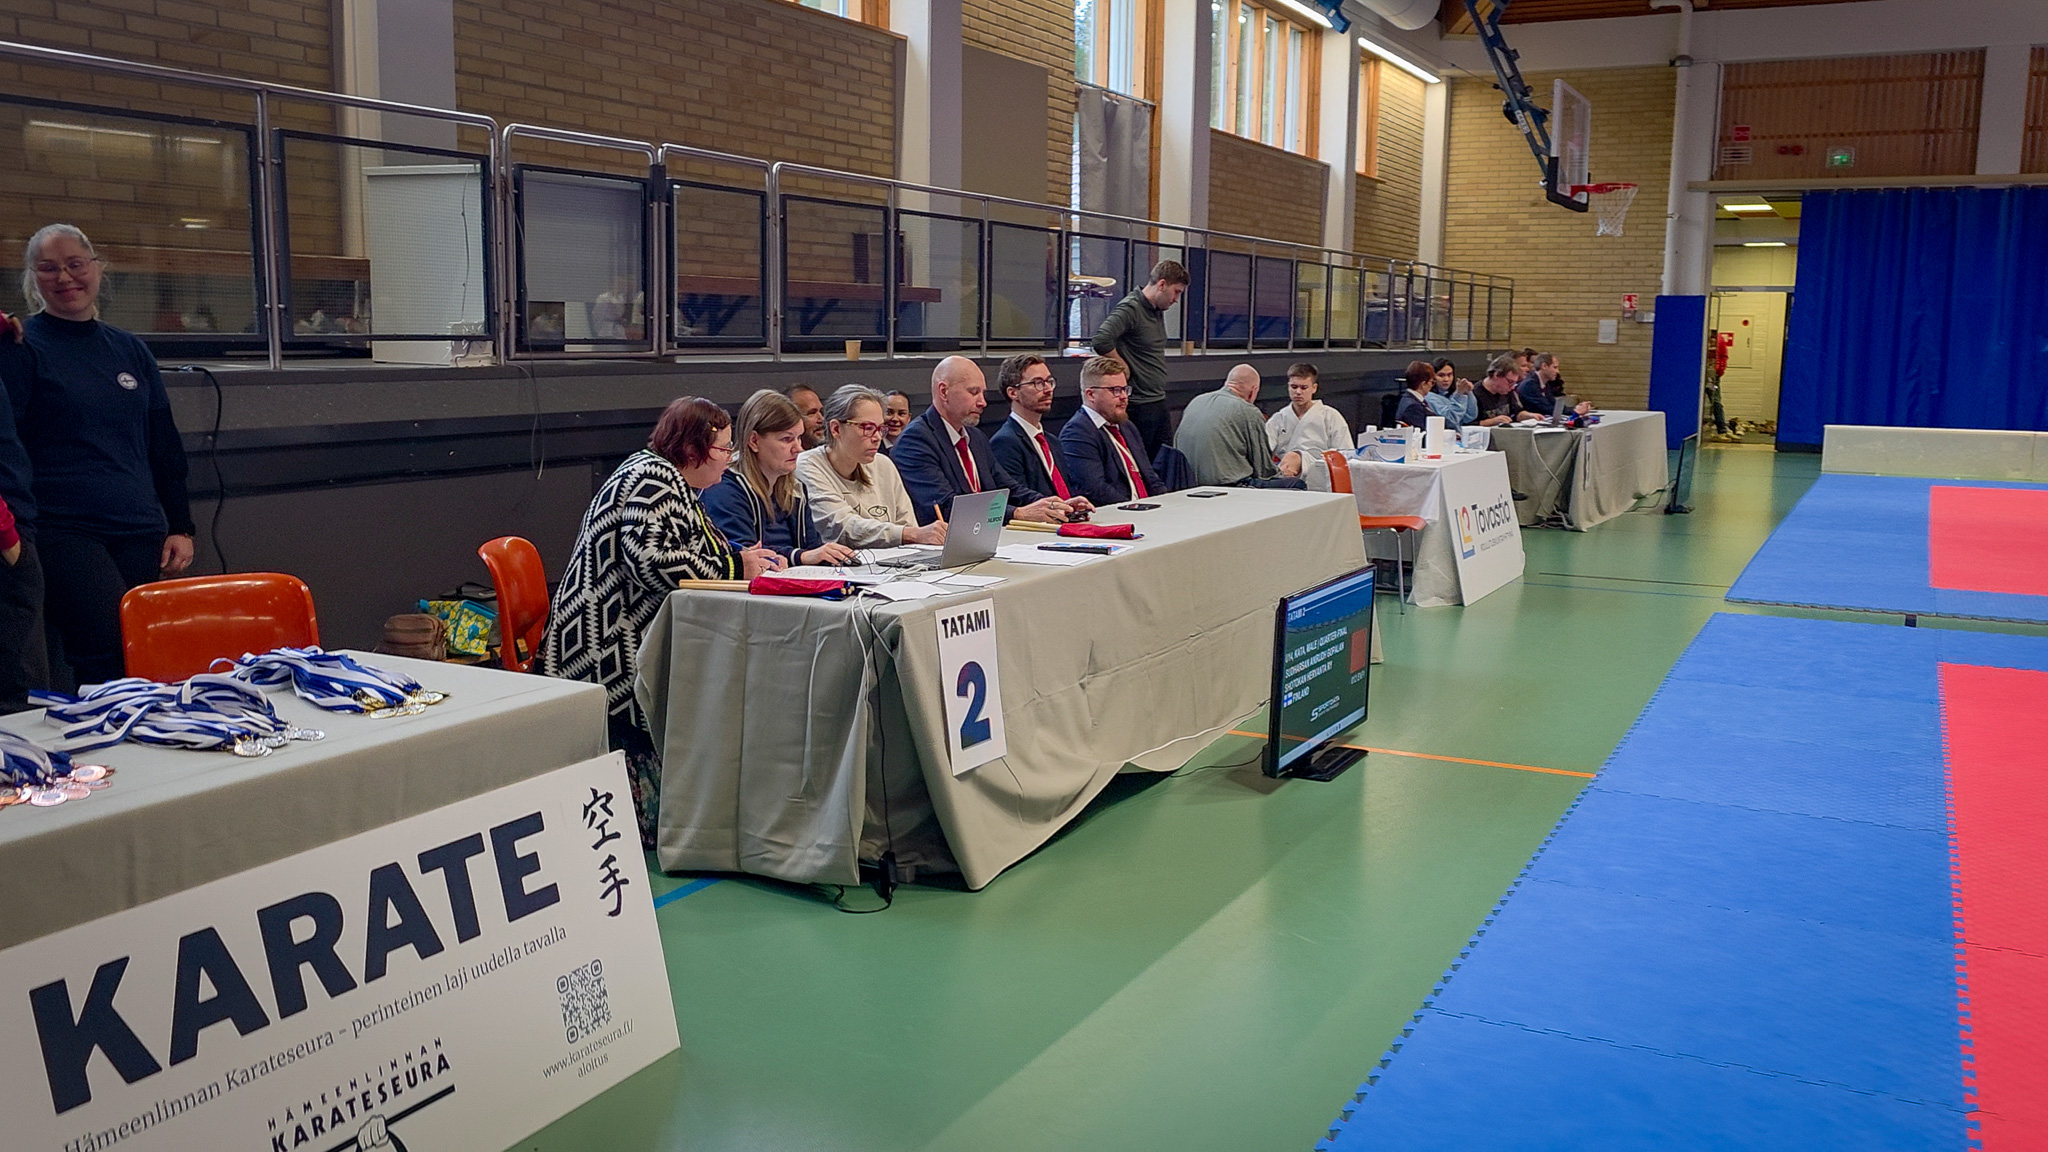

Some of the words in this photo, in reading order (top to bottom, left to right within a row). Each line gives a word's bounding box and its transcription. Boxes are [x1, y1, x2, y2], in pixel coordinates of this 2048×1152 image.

[1471, 493, 1511, 535] Tavastia
[941, 609, 991, 639] TATAMI
[1287, 609, 1302, 622] TATAMI
[1306, 639, 1318, 652] MALE
[1320, 626, 1348, 647] QUARTER-FINAL
[957, 660, 992, 751] 2
[1284, 674, 1307, 693] SHOTOKAN
[1292, 686, 1310, 702] FINLAND
[582, 786, 630, 918] 空手
[29, 811, 560, 1115] KARATE
[63, 1081, 221, 1152] Hämeenlinnan
[226, 1031, 335, 1092] Karateseura
[352, 981, 443, 1040] perinteinen
[444, 966, 469, 991] laji
[471, 946, 521, 980] uudella
[523, 926, 568, 957] tavalla
[542, 1018, 634, 1079] www.karateseura.fi/
[267, 1037, 442, 1132] HÄMEENLINNAN
[577, 1053, 609, 1078] aloitus
[271, 1053, 450, 1152] KARATESEURA
